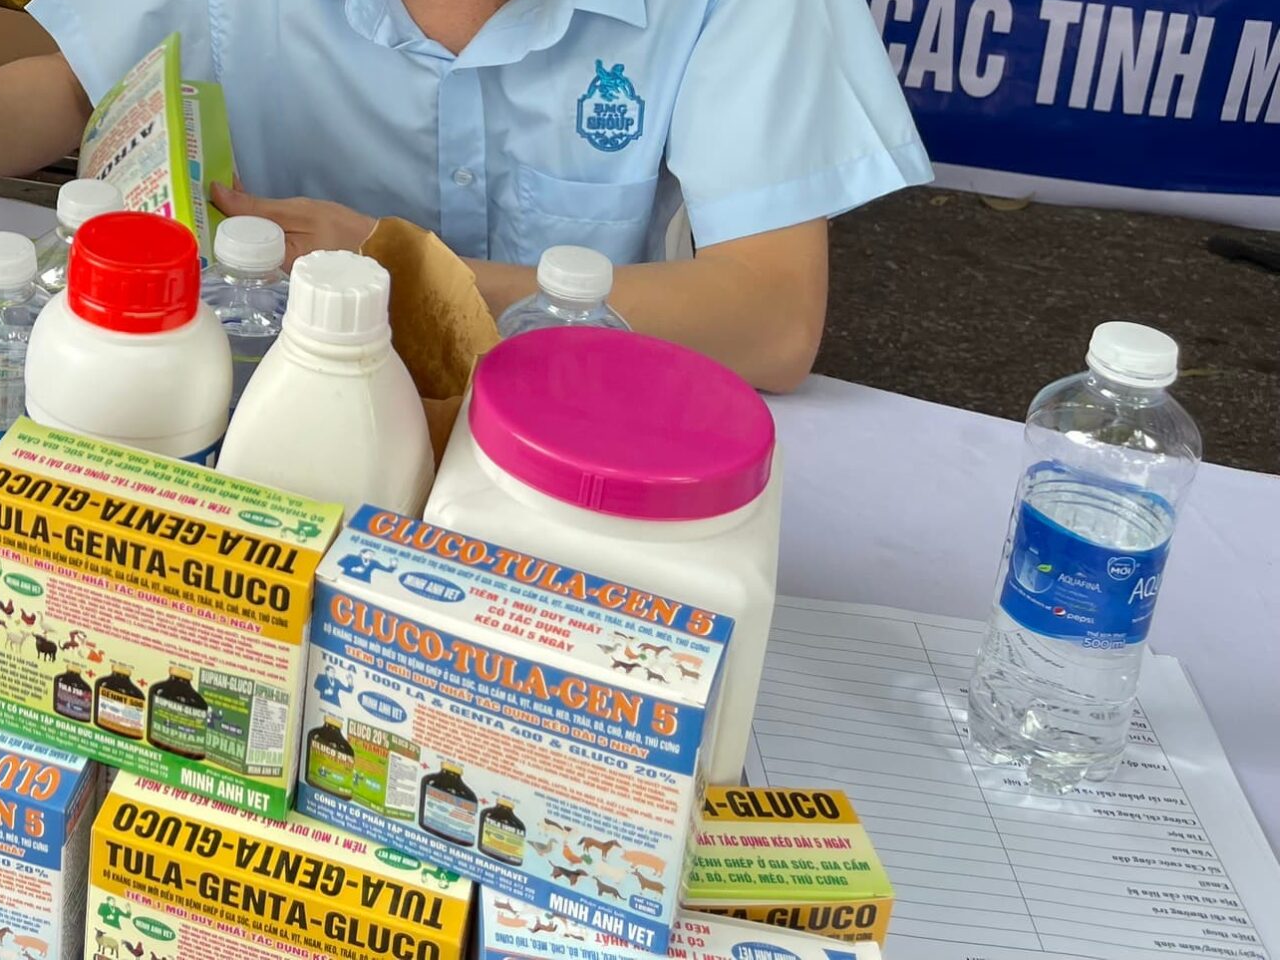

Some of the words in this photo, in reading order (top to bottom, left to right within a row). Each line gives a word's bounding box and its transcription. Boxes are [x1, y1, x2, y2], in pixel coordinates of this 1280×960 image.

[368, 511, 682, 626] GLUCO-TULA-GEN
[687, 609, 716, 636] 5
[1058, 572, 1102, 594] AQUAFINA
[474, 614, 499, 628] KÉO
[502, 623, 523, 637] DÀI
[538, 634, 574, 652] NGÀY
[488, 605, 505, 617] CÓ
[508, 610, 531, 626] TÁC
[534, 621, 570, 639] DỤNG
[1066, 611, 1095, 625] pepsi
[330, 594, 643, 727] GLUCO-TULA-GEN
[651, 701, 678, 737] 5
[321, 650, 357, 674] TULA
[364, 669, 401, 691] 1000
[406, 686, 425, 701] LA
[449, 704, 504, 730] GENTA
[510, 727, 543, 743] 400
[569, 744, 628, 770] GLUCO
[634, 761, 676, 785] 20%
[181, 767, 214, 790] MINH
[216, 778, 243, 799] ANH
[247, 788, 270, 812] VET
[25, 807, 45, 837] 5
[113, 803, 442, 930] TULA-GENTA-GLUCO
[105, 840, 440, 960] TULA-GENTA-GLUCO
[549, 893, 589, 923] MINH
[592, 909, 625, 938] ANH
[628, 922, 655, 947] VET
